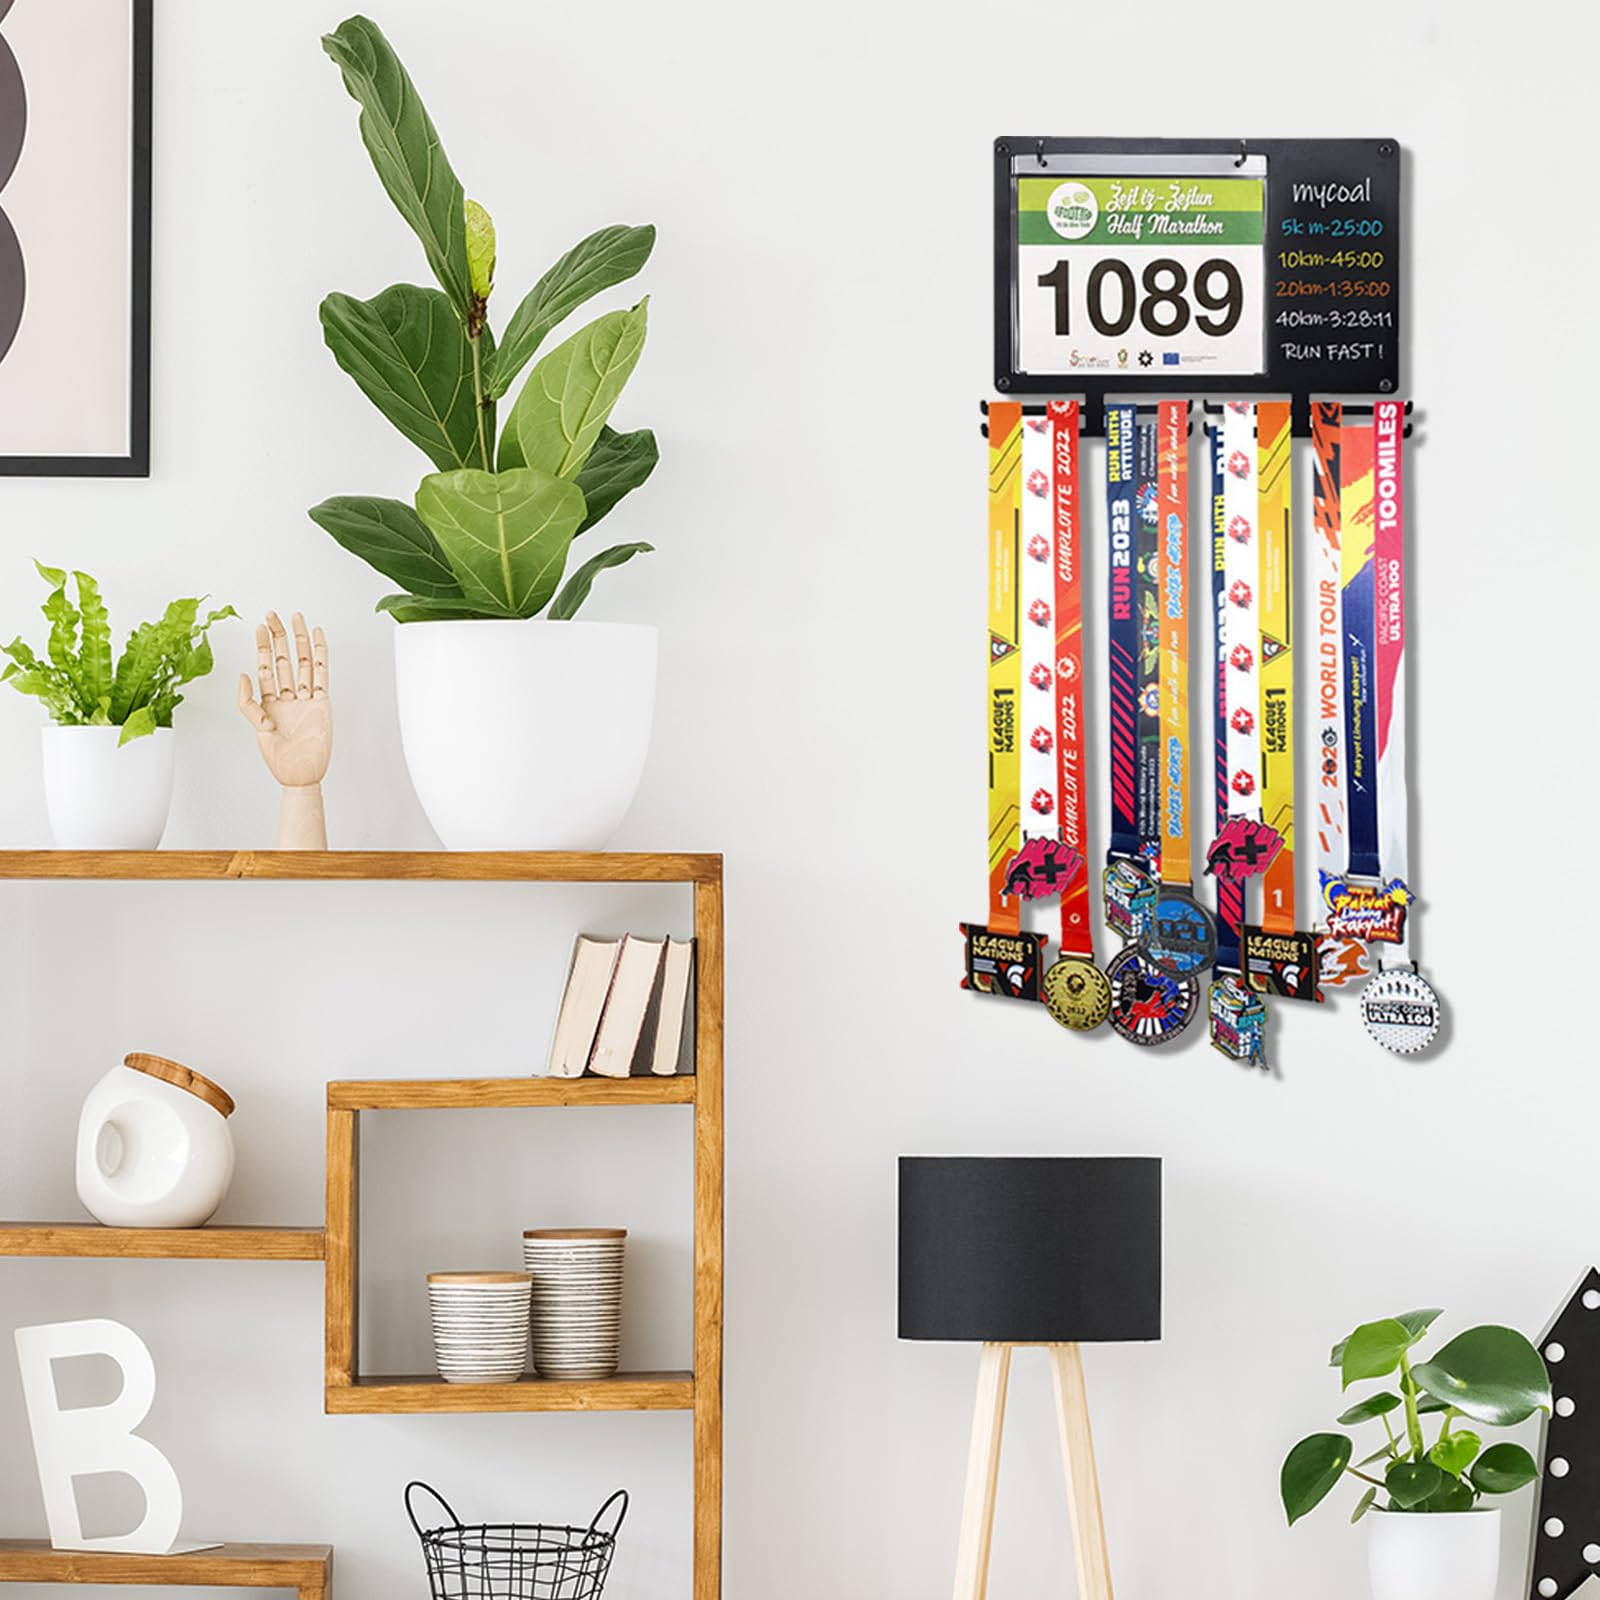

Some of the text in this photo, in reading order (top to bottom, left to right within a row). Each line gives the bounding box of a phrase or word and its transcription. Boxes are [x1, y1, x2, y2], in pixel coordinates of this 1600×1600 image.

[1292, 177, 1371, 208] mycoal
[1106, 213, 1223, 240] Half Marathon
[1277, 249, 1384, 270] 10km-45:00
[1037, 257, 1244, 337] 1089
[1275, 279, 1391, 299] 20km-1:35:00
[1275, 309, 1393, 329] 40km-3:28:11
[1280, 342, 1322, 360] RUN
[1108, 410, 1120, 482] RUN WITH
[1120, 409, 1132, 481] ATTITUDE
[1379, 404, 1397, 531] 100MILES
[1055, 428, 1073, 582] CHARLOTTE 2022
[1112, 499, 1131, 620] RUN2023
[1319, 579, 1336, 636] TOUR
[1378, 556, 1389, 645] PACIFIC COAST
[1389, 559, 1401, 641] ULTRA 100
[1320, 642, 1337, 719] WORLD
[993, 701, 1004, 753] LEAGUE
[1004, 699, 1014, 753] NATIONS
[1062, 693, 1077, 740] 2022
[1265, 701, 1276, 753] LEAGUE
[1276, 699, 1286, 753] NATIONS
[1352, 699, 1363, 740] Lindung
[1353, 741, 1364, 778] Rakyat
[1272, 888, 1283, 908] 1
[1334, 893, 1391, 915] Rakyat
[972, 935, 1033, 954] LEAGUE 1
[972, 946, 1024, 962] NATIONS
[1247, 936, 1307, 954] LEAGUE 1
[1247, 946, 1299, 962] NATIONS
[1369, 1012, 1432, 1025] ULTRA 100
[14, 1318, 183, 1556] B
